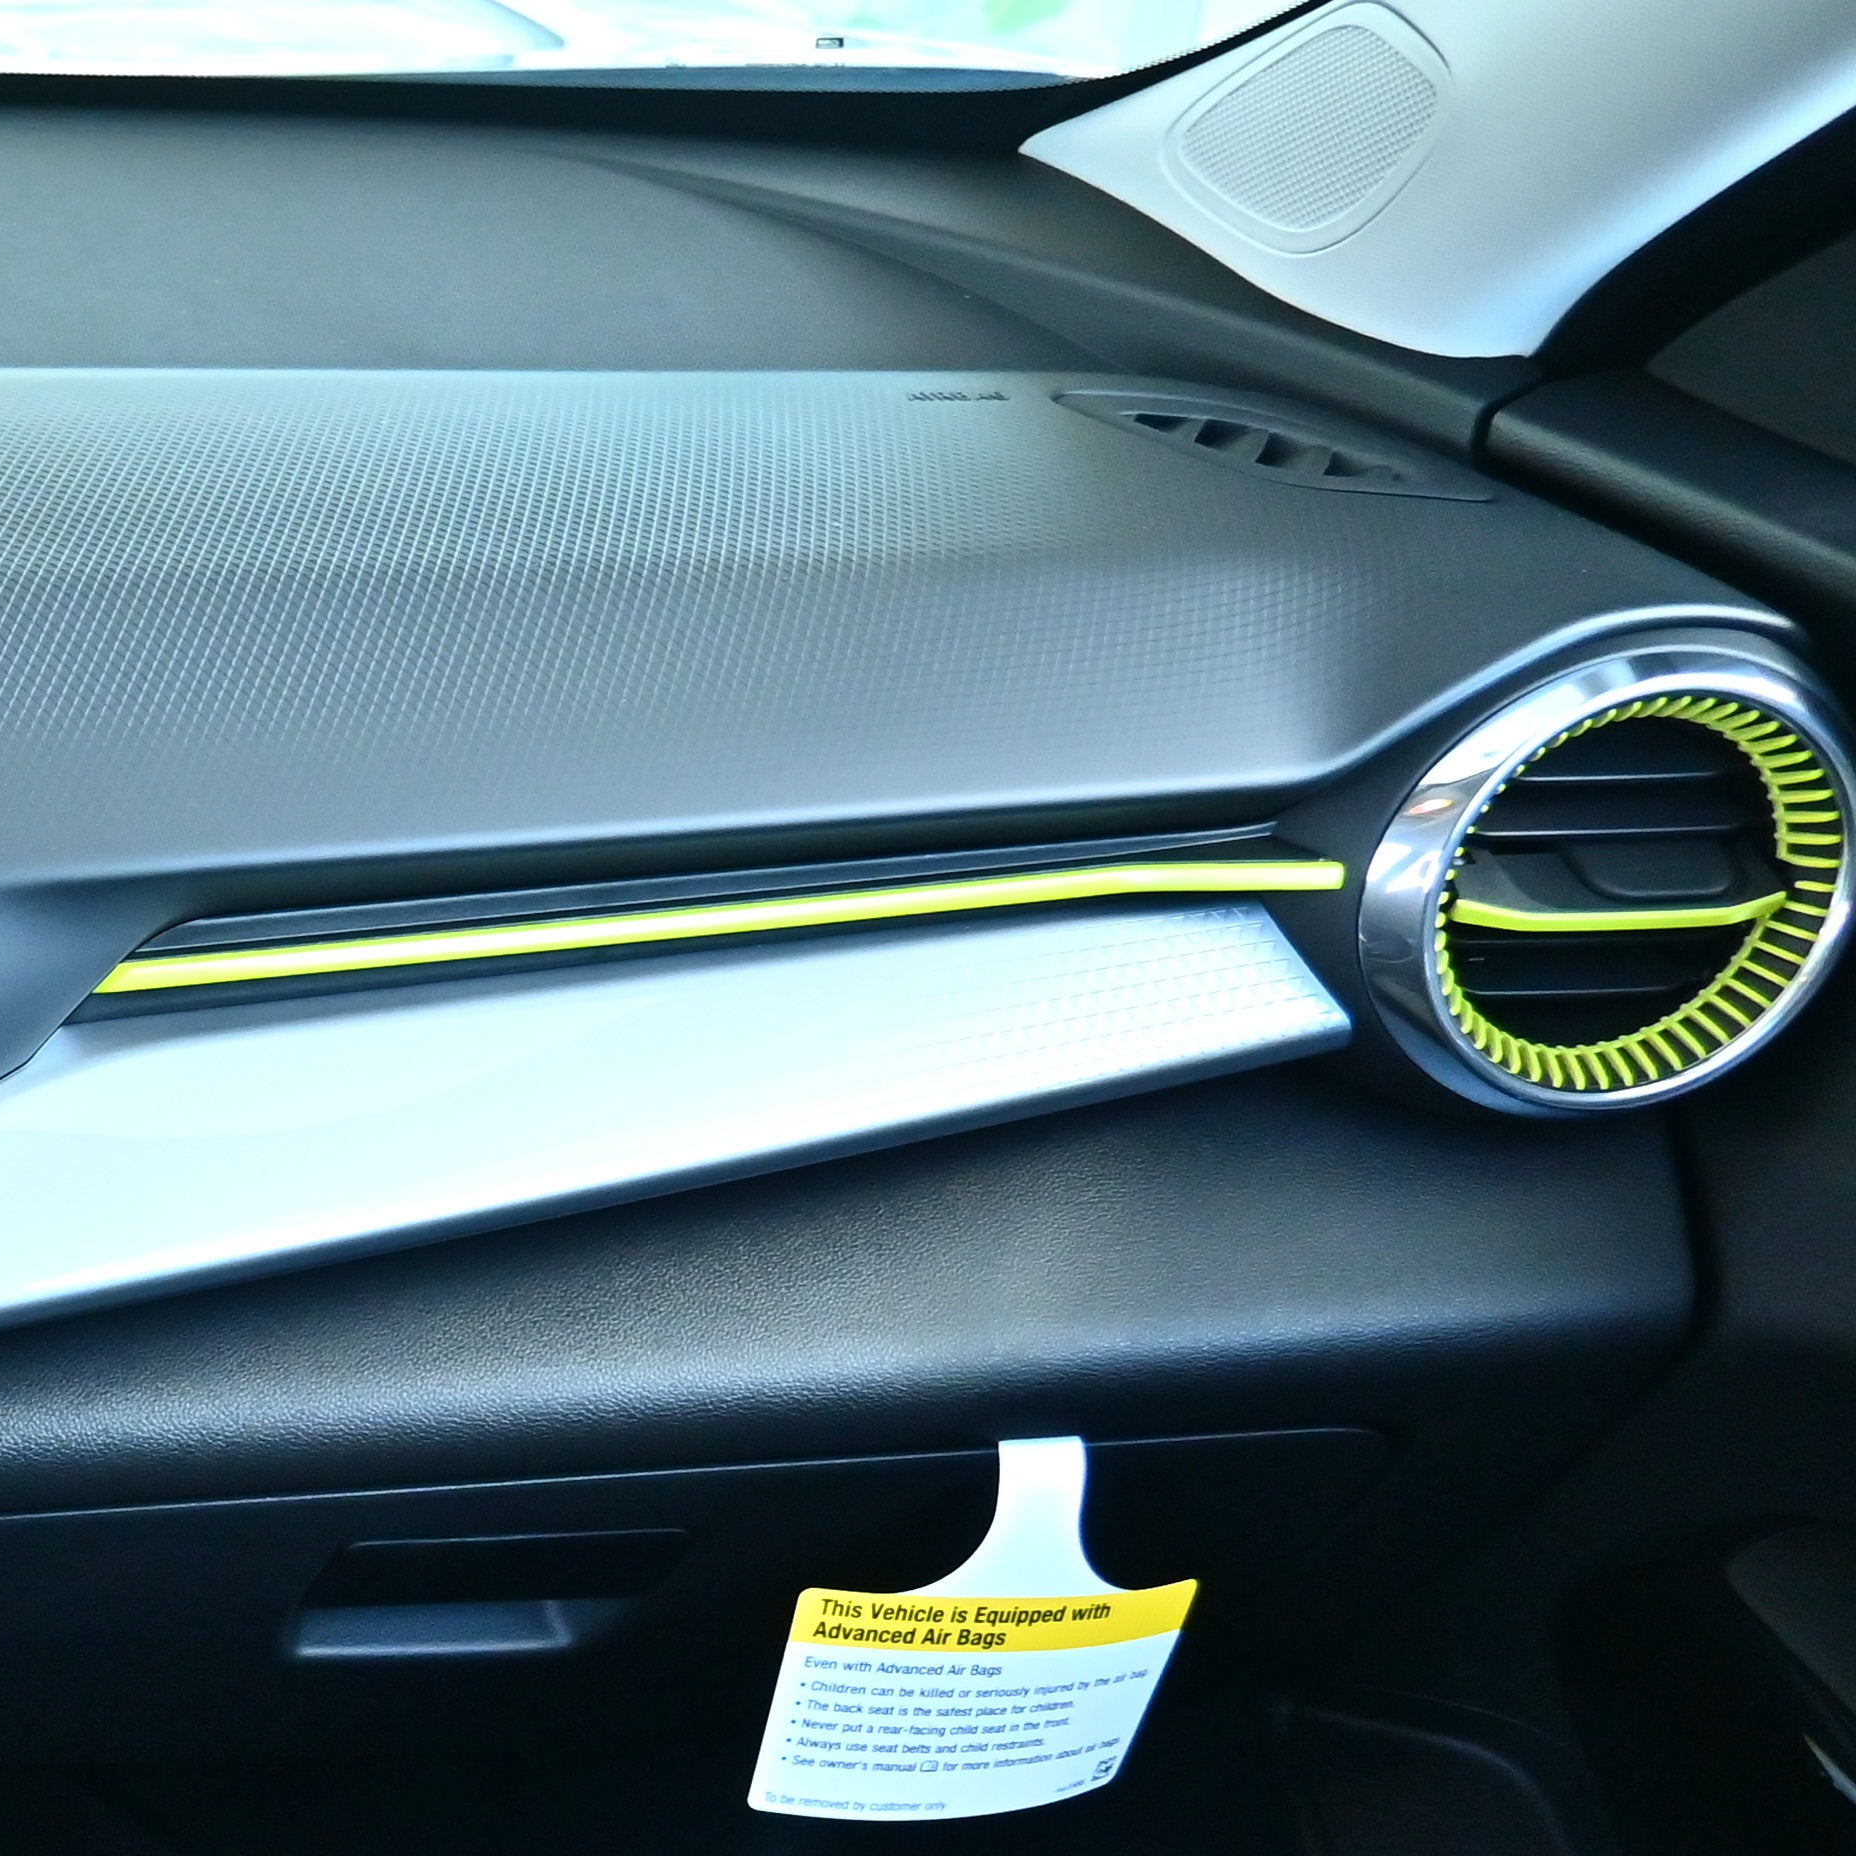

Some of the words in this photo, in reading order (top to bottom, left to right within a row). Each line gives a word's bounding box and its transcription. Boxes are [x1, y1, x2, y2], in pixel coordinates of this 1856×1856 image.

[821, 1599, 863, 1618] This
[871, 1603, 944, 1623] Vehicle
[950, 1606, 968, 1623] is
[974, 1606, 1067, 1627] Equipped
[1071, 1603, 1111, 1621] with
[812, 1621, 917, 1645] Advanced
[921, 1628, 952, 1645] Air
[956, 1629, 1006, 1649] Bags
[804, 1656, 837, 1670] Even
[843, 1661, 872, 1673] with
[876, 1662, 944, 1676] Advanced
[947, 1665, 966, 1676] Air
[970, 1665, 1002, 1678] Bags
[810, 1681, 866, 1696] Children
[870, 1687, 894, 1697] can
[899, 1686, 915, 1698] be
[919, 1687, 954, 1699] killed
[958, 1689, 971, 1698] or
[975, 1686, 1030, 1698] seriously
[1034, 1682, 1075, 1695] injured
[1077, 1680, 1090, 1692] by
[1093, 1676, 1110, 1687] the
[807, 1699, 829, 1711] The
[833, 1701, 863, 1714] back
[867, 1706, 894, 1715] seat
[898, 1707, 909, 1716] is
[912, 1707, 932, 1717] the
[935, 1707, 972, 1717] safest
[975, 1705, 1007, 1717] place
[1010, 1704, 1027, 1715] for
[801, 1718, 839, 1731] Never
[842, 1723, 862, 1734] put
[866, 1726, 874, 1734] a
[877, 1725, 946, 1737] rear-facing
[949, 1724, 978, 1735] child
[981, 1723, 1006, 1734] seat
[1009, 1722, 1020, 1732] in
[1023, 1721, 1040, 1730] the
[796, 1737, 842, 1751] Always
[845, 1743, 868, 1751] use
[872, 1744, 899, 1753] seat
[901, 1744, 931, 1754] belts
[935, 1744, 957, 1754] and
[960, 1742, 988, 1753] child
[991, 1737, 1046, 1751] restraints.
[792, 1755, 816, 1767] See
[819, 1759, 868, 1771] owner's
[872, 1762, 916, 1772] manual
[942, 1761, 958, 1771] for
[961, 1761, 990, 1770] more
[993, 1753, 1054, 1768] information
[765, 1791, 777, 1803] To
[780, 1795, 795, 1804] be
[798, 1797, 849, 1810] removed
[852, 1799, 866, 1811] by
[869, 1800, 922, 1811] customer
